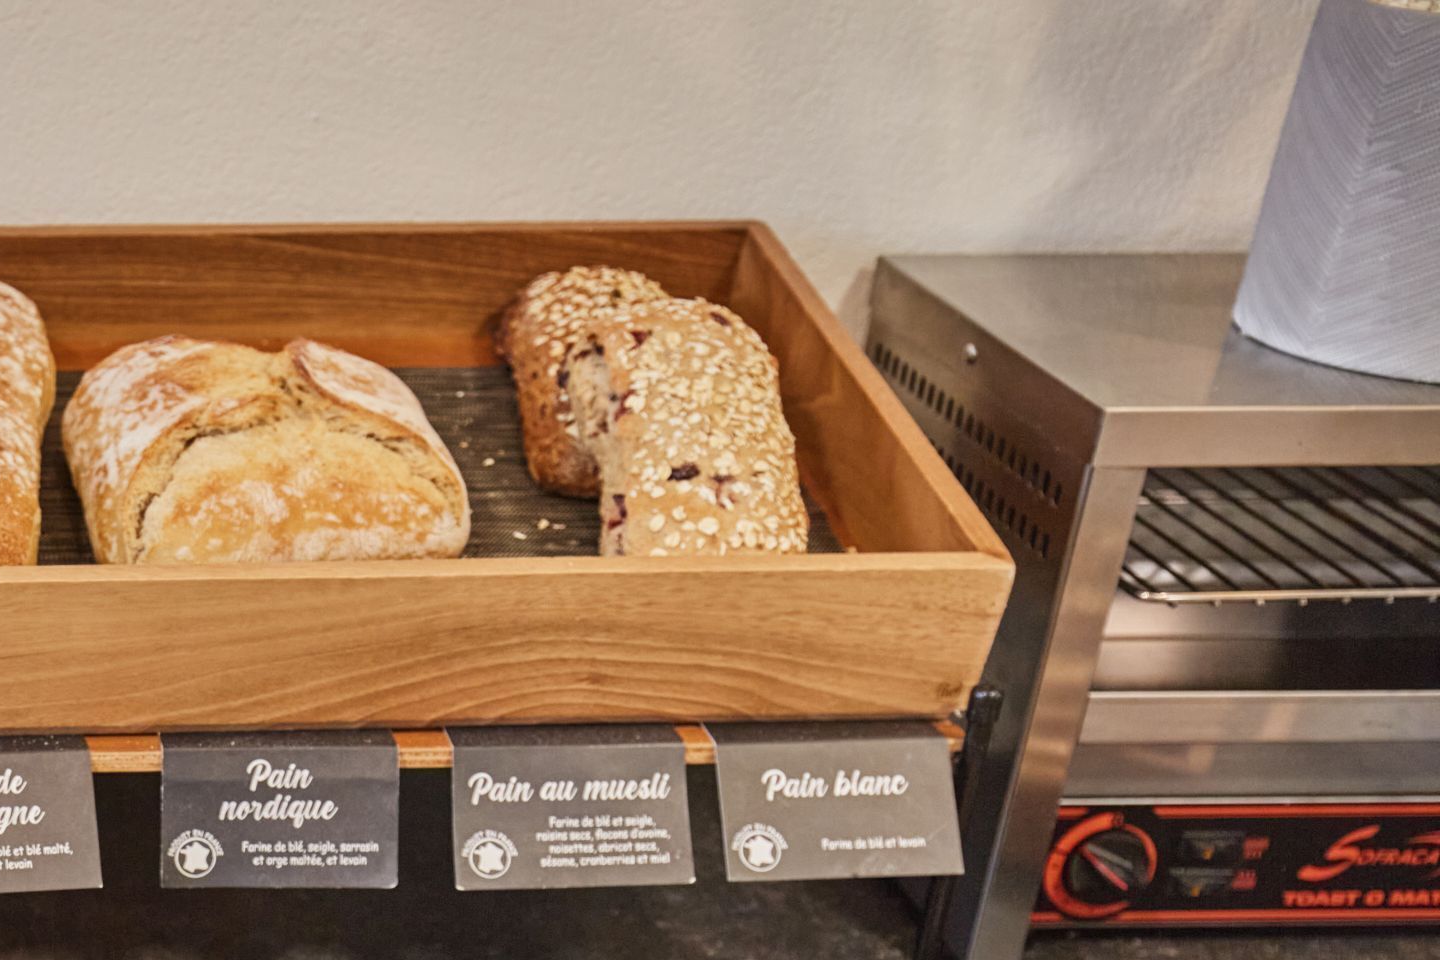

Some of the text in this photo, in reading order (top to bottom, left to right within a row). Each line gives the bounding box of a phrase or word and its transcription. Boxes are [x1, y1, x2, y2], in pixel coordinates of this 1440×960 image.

[246, 758, 314, 792] Pain
[468, 772, 671, 806] Pain au muesli
[761, 768, 909, 801] Pain blanc
[218, 794, 339, 828] nordique
[549, 815, 580, 828] Farine
[581, 815, 594, 828] de
[595, 814, 611, 827] blé
[611, 815, 623, 827] et
[535, 830, 568, 841] raisins
[595, 828, 629, 840] flocons
[12, 845, 24, 857] et
[25, 843, 42, 856] blé
[43, 842, 74, 855] malté,
[241, 840, 273, 853] Farine
[274, 840, 287, 853] de
[307, 840, 338, 855] seigle,
[339, 840, 379, 853] sarrasin
[598, 841, 633, 852] abricot
[821, 837, 853, 851] Farine
[854, 837, 867, 850] de
[884, 837, 896, 849] et
[897, 835, 927, 848] levain
[5, 858, 33, 870] levain
[252, 854, 368, 869] et orge maltée, et levain
[636, 854, 648, 865] et
[649, 851, 671, 864] miel
[1283, 889, 1362, 907] TOAST
